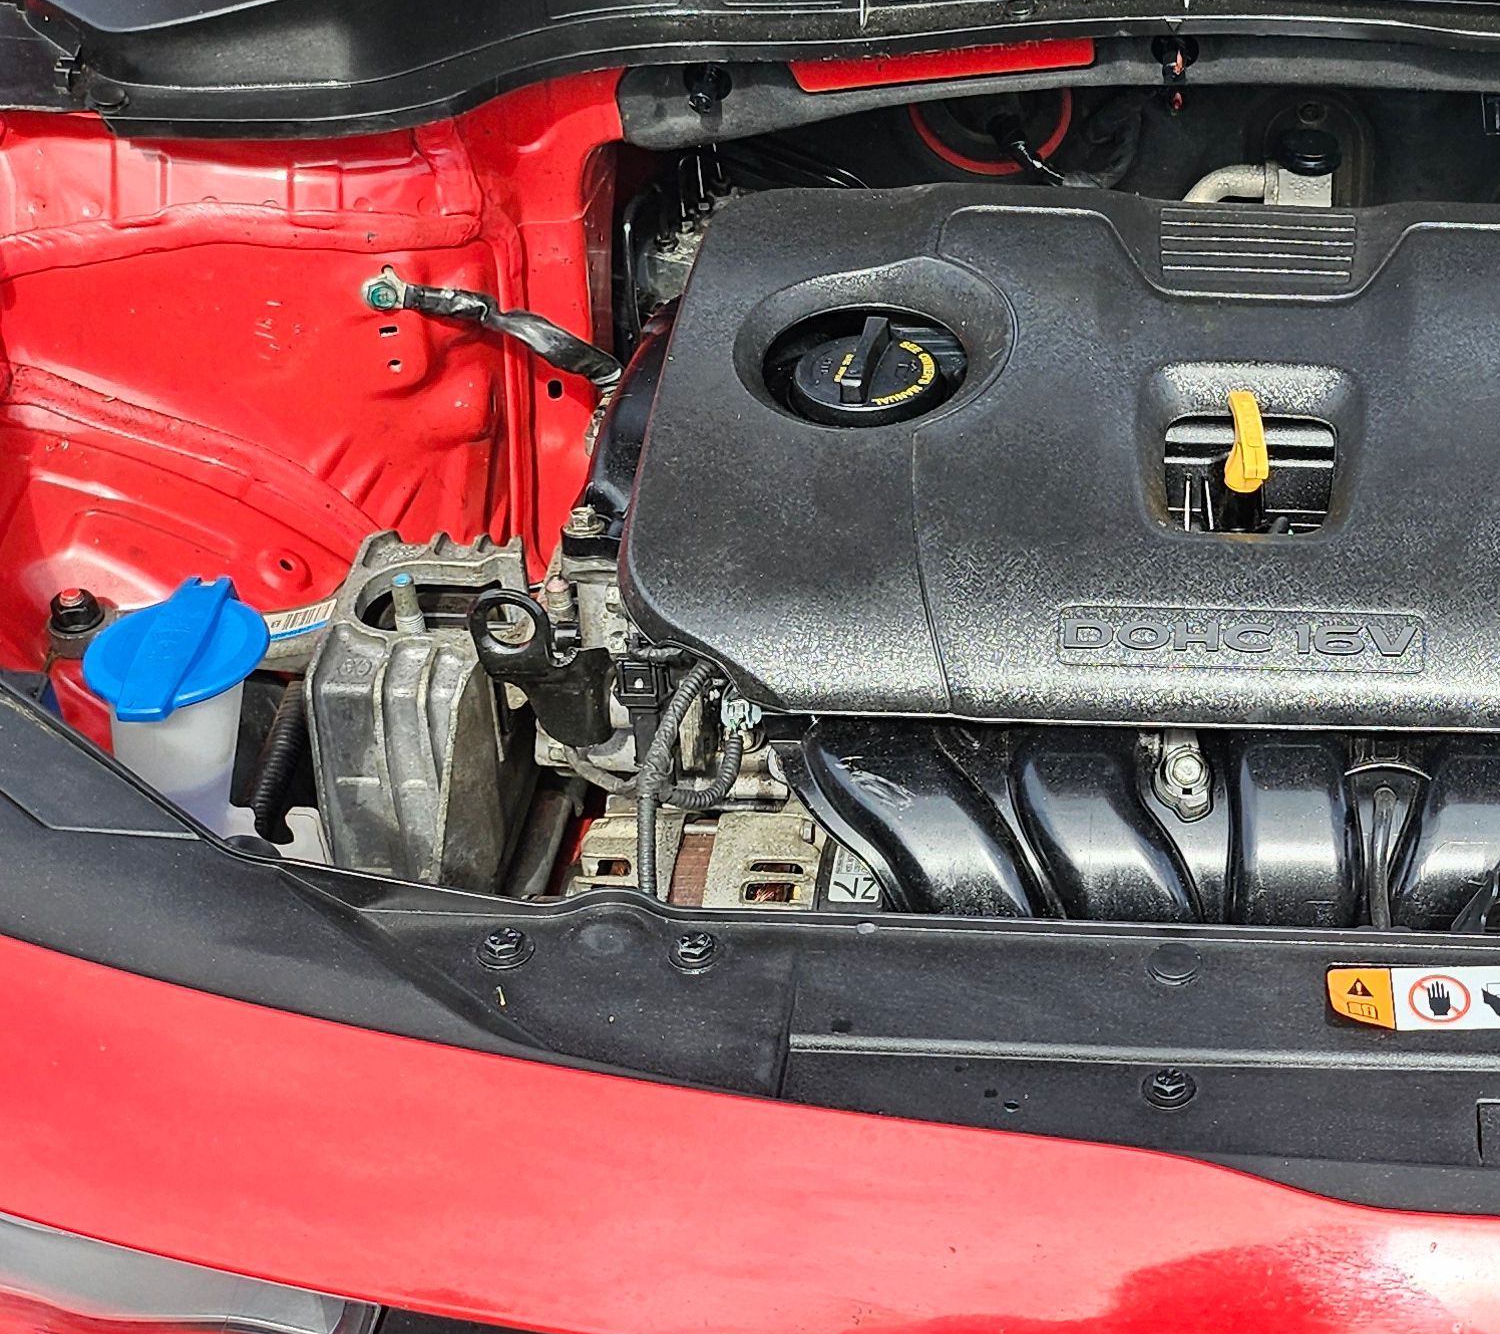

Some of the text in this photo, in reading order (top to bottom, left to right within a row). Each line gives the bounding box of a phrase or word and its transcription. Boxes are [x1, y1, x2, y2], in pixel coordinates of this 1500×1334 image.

[899, 340, 924, 354] SEE
[871, 384, 924, 406] MANUAL
[1063, 618, 1419, 657] DOHC 16V
